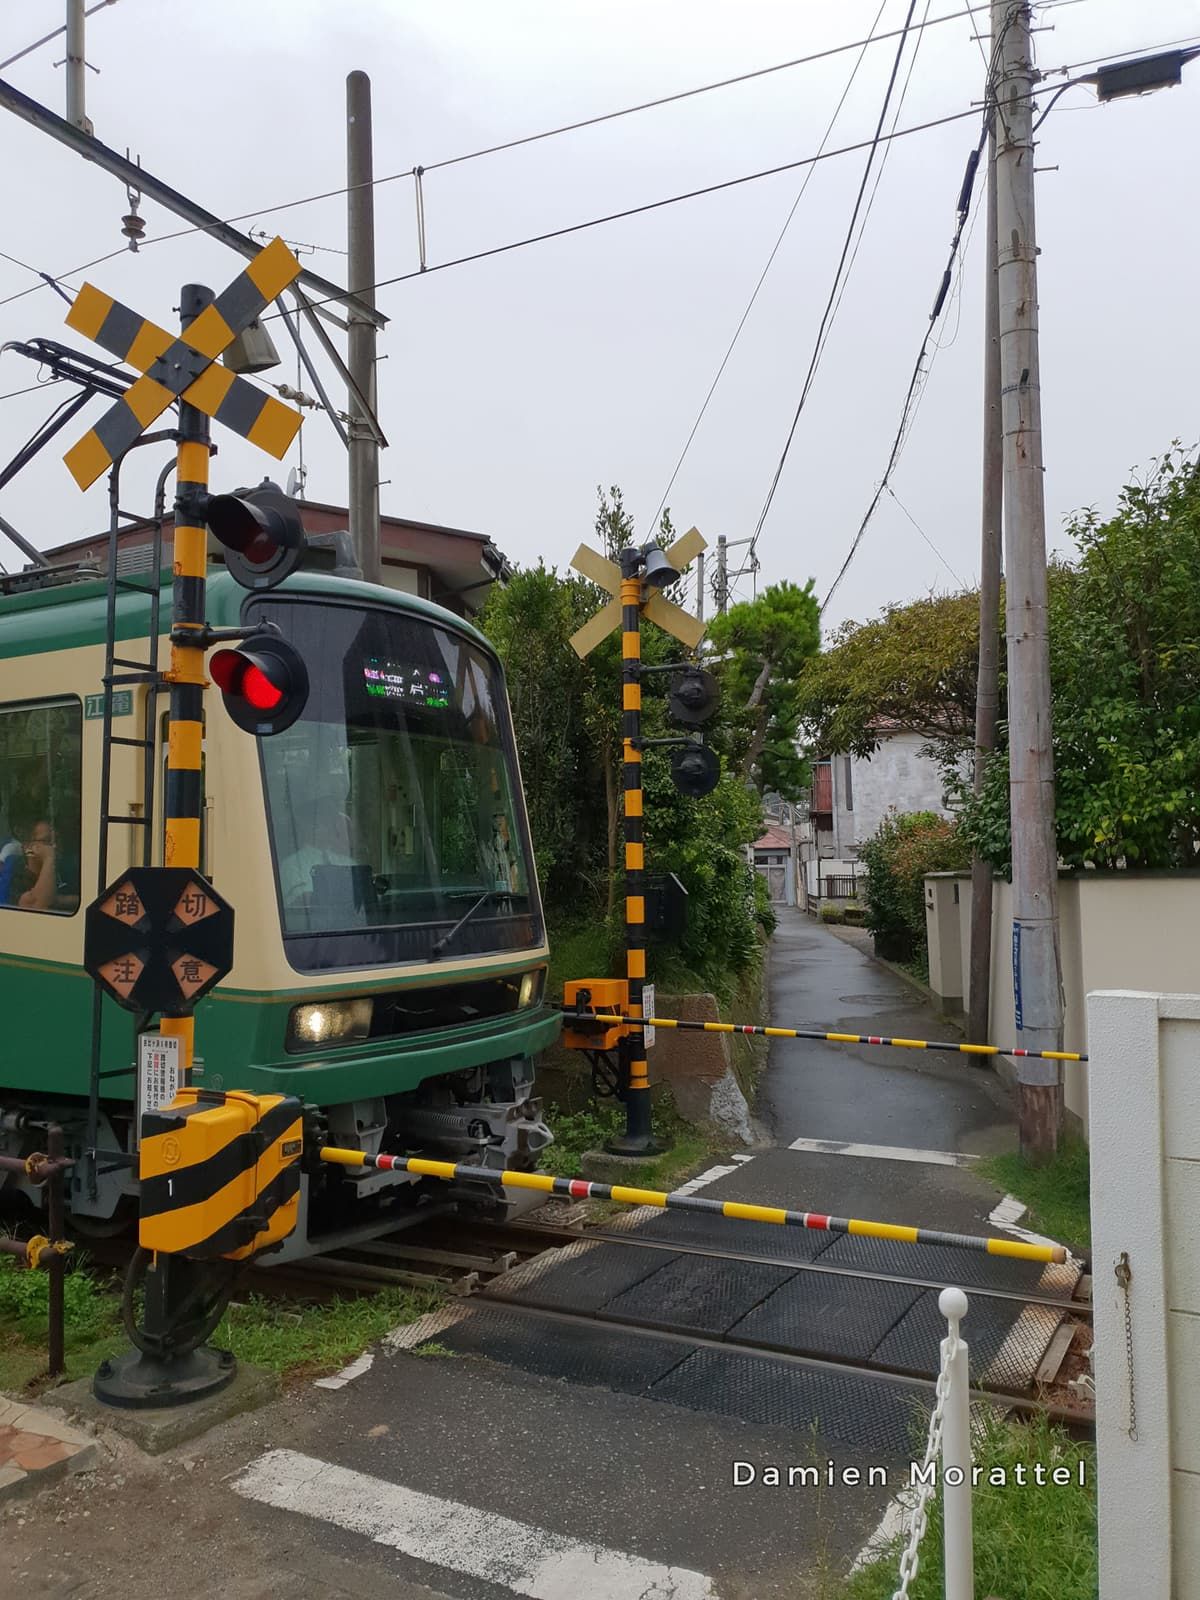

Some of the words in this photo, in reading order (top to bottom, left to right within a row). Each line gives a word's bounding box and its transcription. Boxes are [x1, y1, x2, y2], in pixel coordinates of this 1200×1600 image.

[114, 892, 206, 917] 踏切
[113, 959, 203, 983] 注意
[167, 1178, 174, 1197] 1
